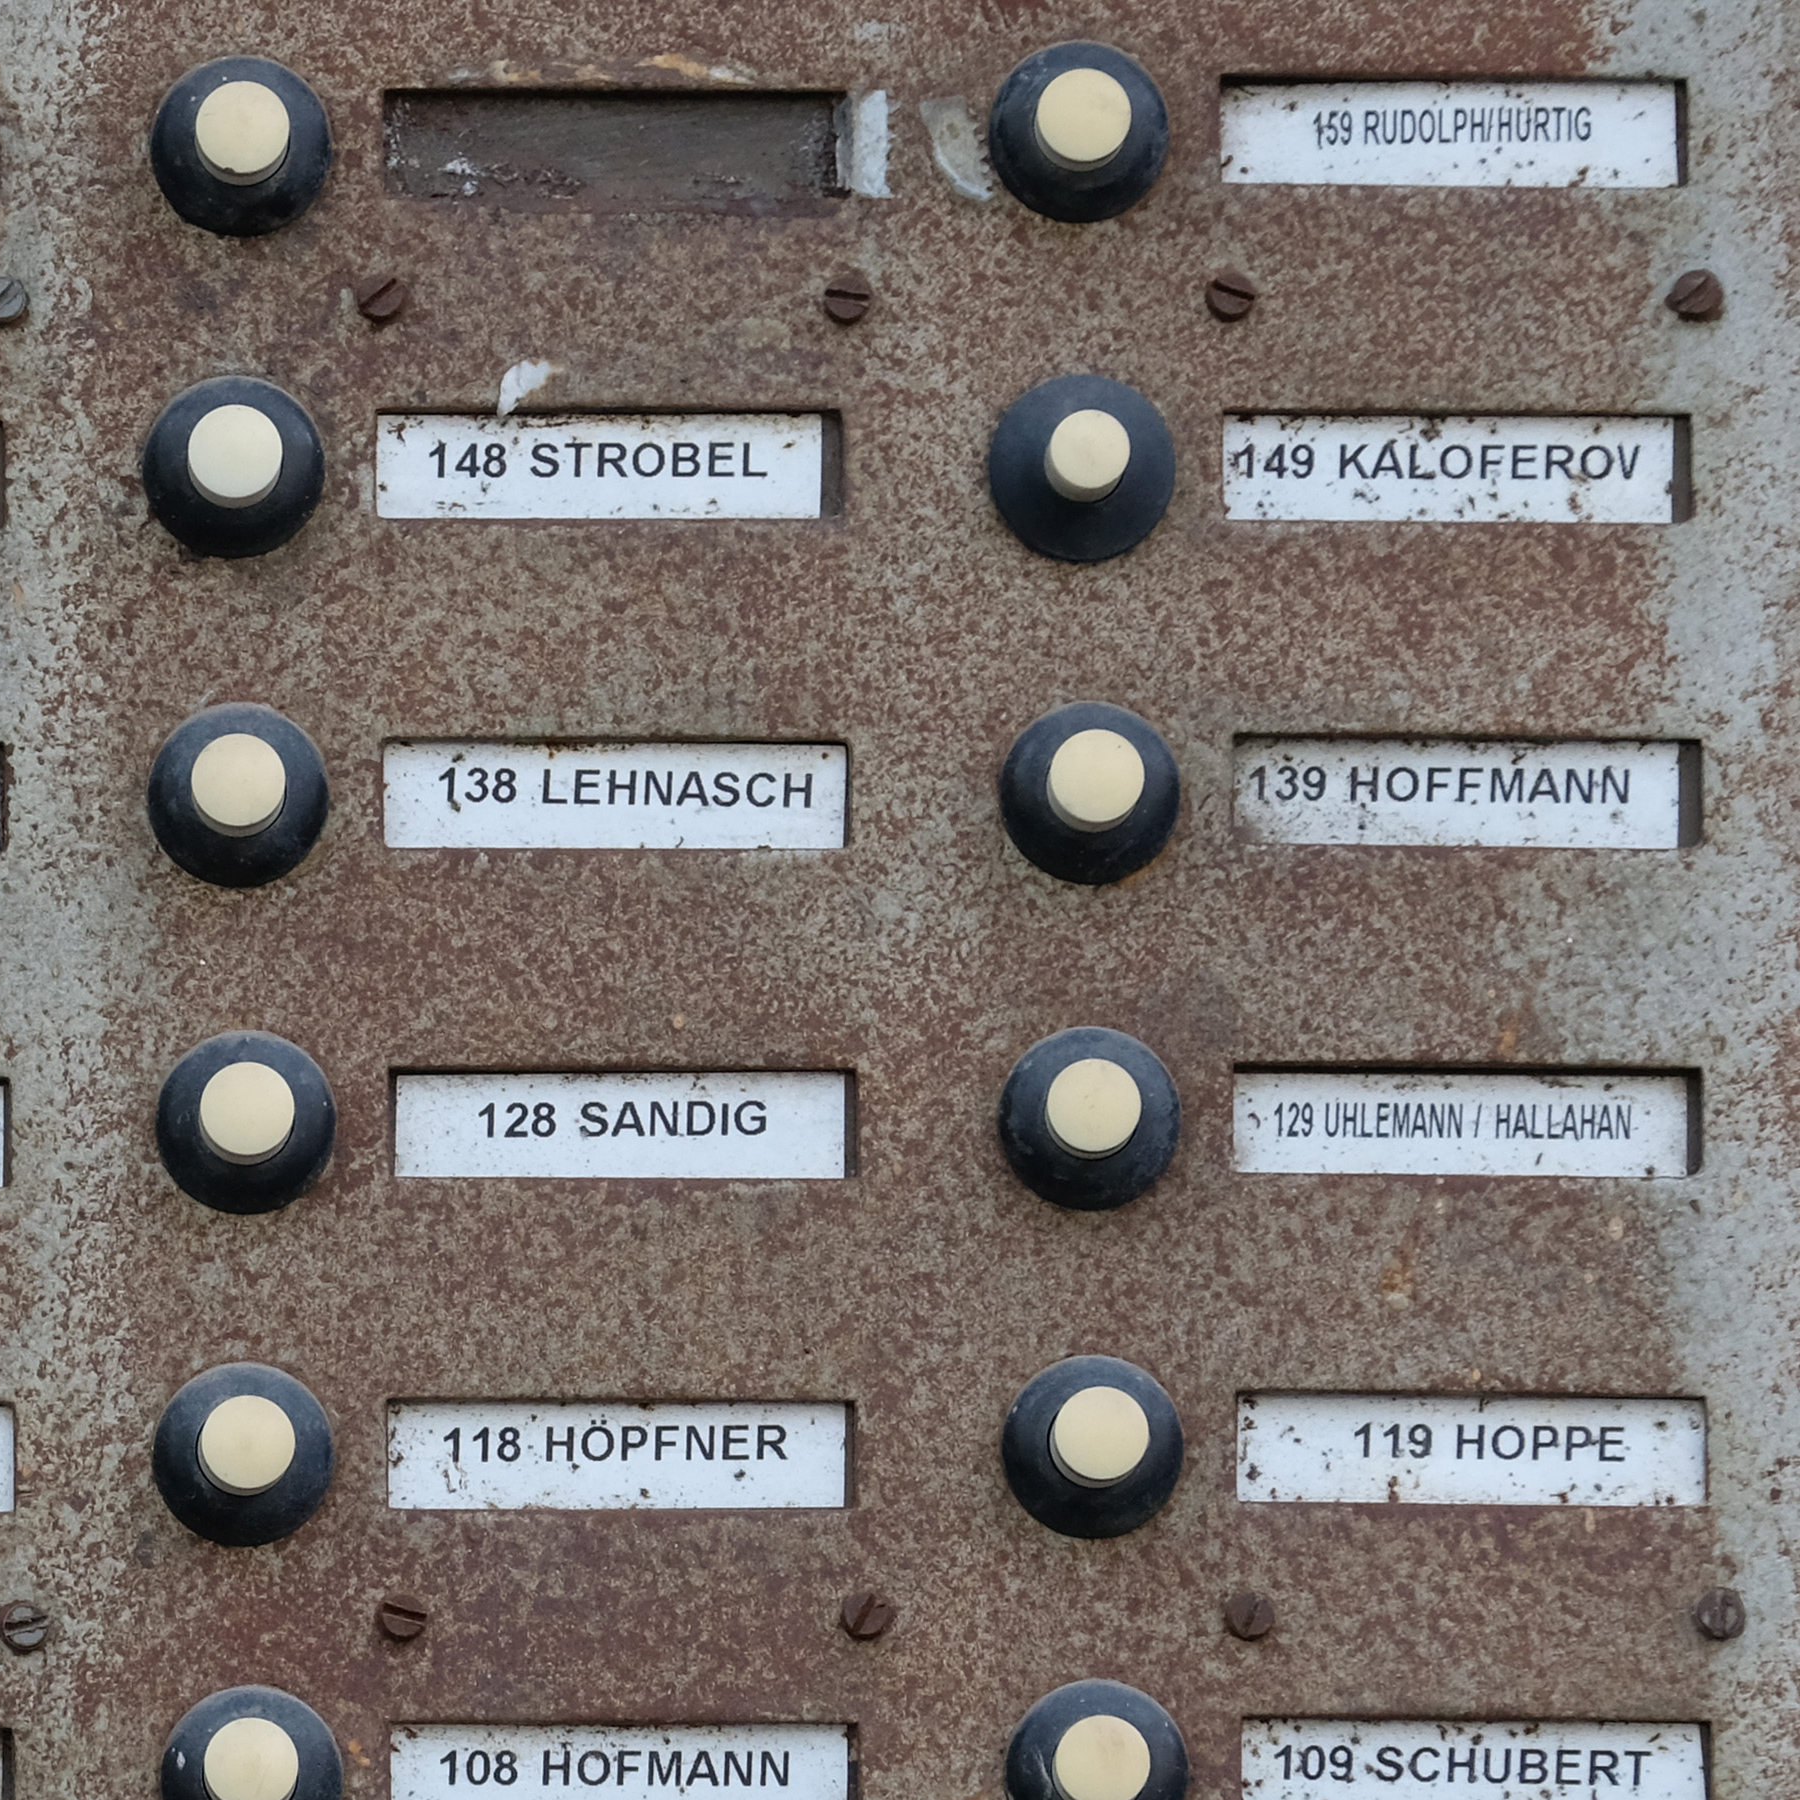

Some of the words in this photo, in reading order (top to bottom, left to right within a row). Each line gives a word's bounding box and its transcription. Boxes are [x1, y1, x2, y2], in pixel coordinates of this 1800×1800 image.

[1313, 109, 1353, 147] 159
[428, 443, 507, 478] 148
[530, 442, 768, 478] STROBEL
[1233, 445, 1315, 480] 149
[1339, 444, 1640, 481] KALOFEROV
[437, 767, 517, 803] 138
[543, 769, 813, 808] LEHNASCH
[1248, 765, 1326, 802] 139
[1349, 766, 1631, 805] HOFFMANN
[477, 1102, 556, 1138] 128
[579, 1100, 768, 1138] SANDIG
[1273, 1102, 1314, 1138] 129
[1324, 1101, 1463, 1139] UHLEMANN
[1473, 1103, 1482, 1138] /
[1495, 1103, 1632, 1141] HALLAHAN
[442, 1427, 521, 1464] 118
[545, 1418, 788, 1462] HÖPFNER
[1352, 1424, 1431, 1459] 119
[1456, 1425, 1626, 1462] HOPPE
[439, 1750, 518, 1786] 108
[541, 1750, 791, 1787] HOFMANN
[1273, 1745, 1353, 1782] 109
[1375, 1746, 1652, 1787] SCHUBERT
